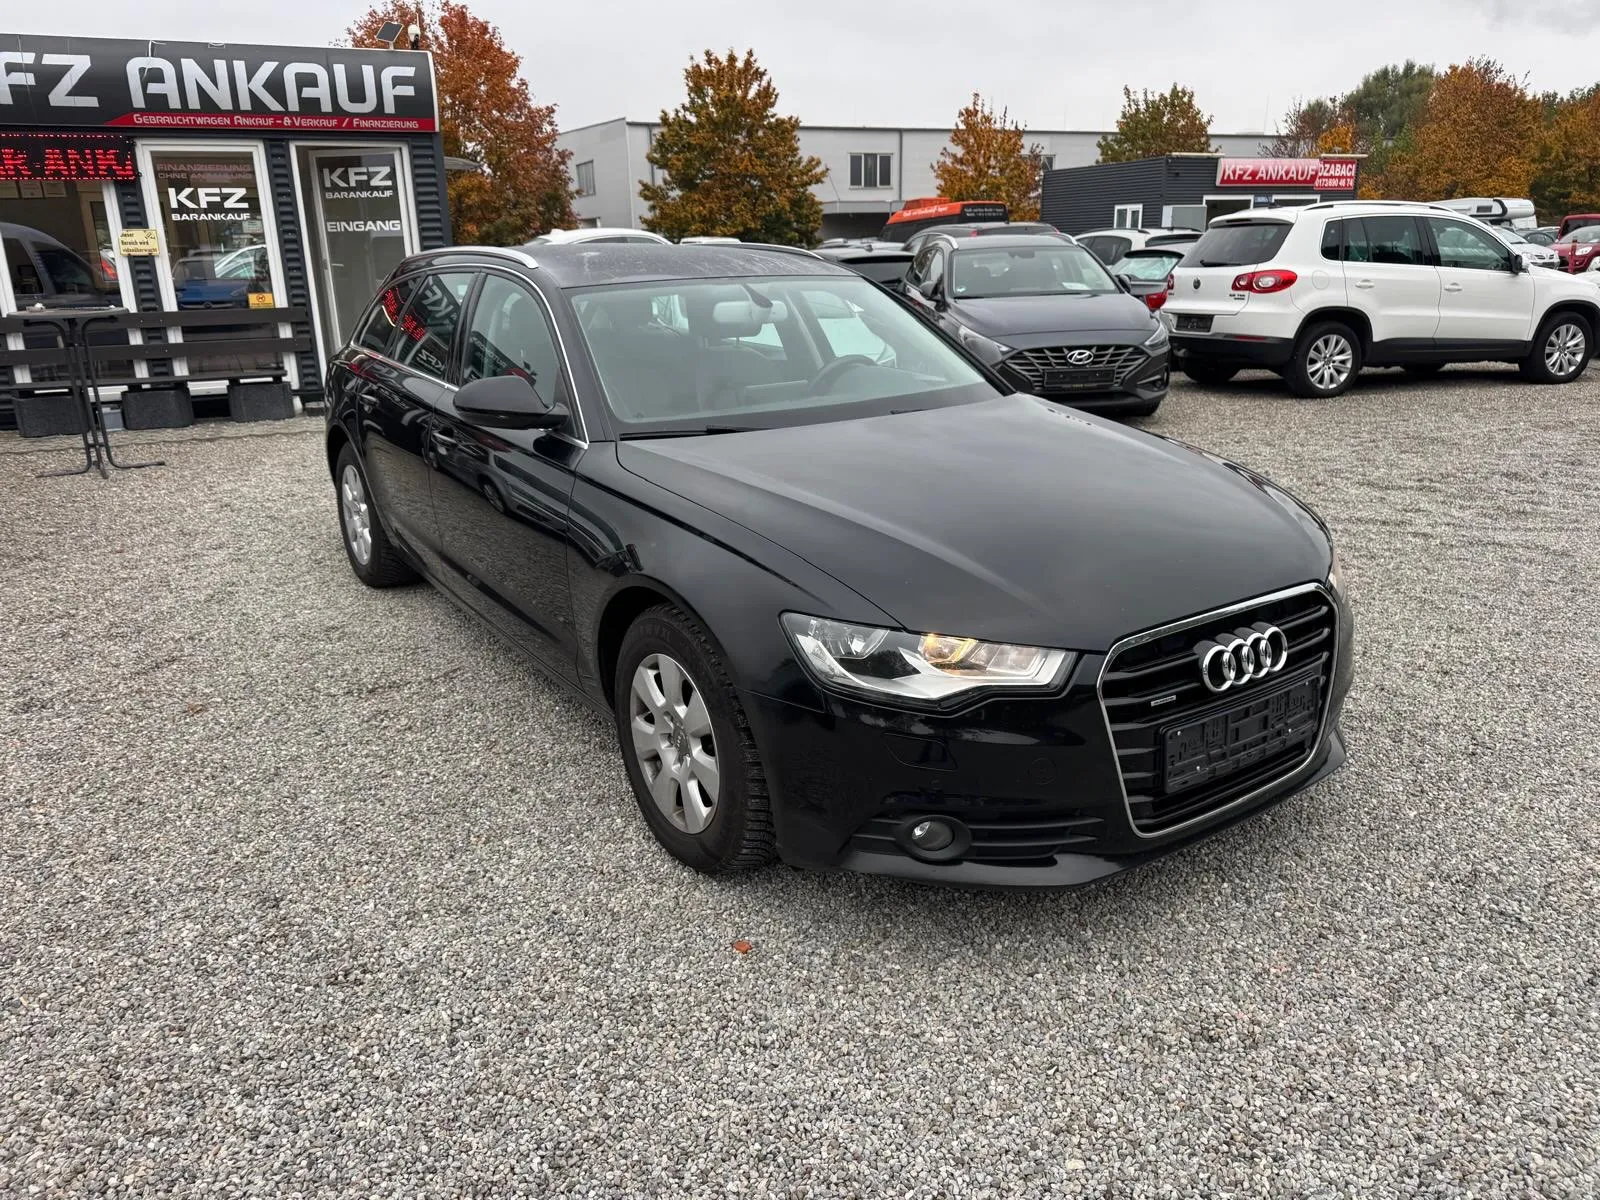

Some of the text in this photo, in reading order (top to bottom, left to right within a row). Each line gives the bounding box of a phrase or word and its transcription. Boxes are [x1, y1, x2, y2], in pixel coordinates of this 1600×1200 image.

[126, 57, 416, 114] ANKAUF
[133, 114, 231, 125] GEBRAUCHTWAGEN
[293, 117, 338, 127] VERKAUF
[353, 118, 419, 128] FINANZIERUNG
[323, 166, 393, 188] KFZ
[1223, 165, 1318, 181] KFZ ANKAUF
[168, 187, 249, 209] KFZ
[325, 190, 394, 199] BARANKAUF
[171, 213, 251, 221] BARANKAUF
[326, 219, 401, 232] EINGANG
